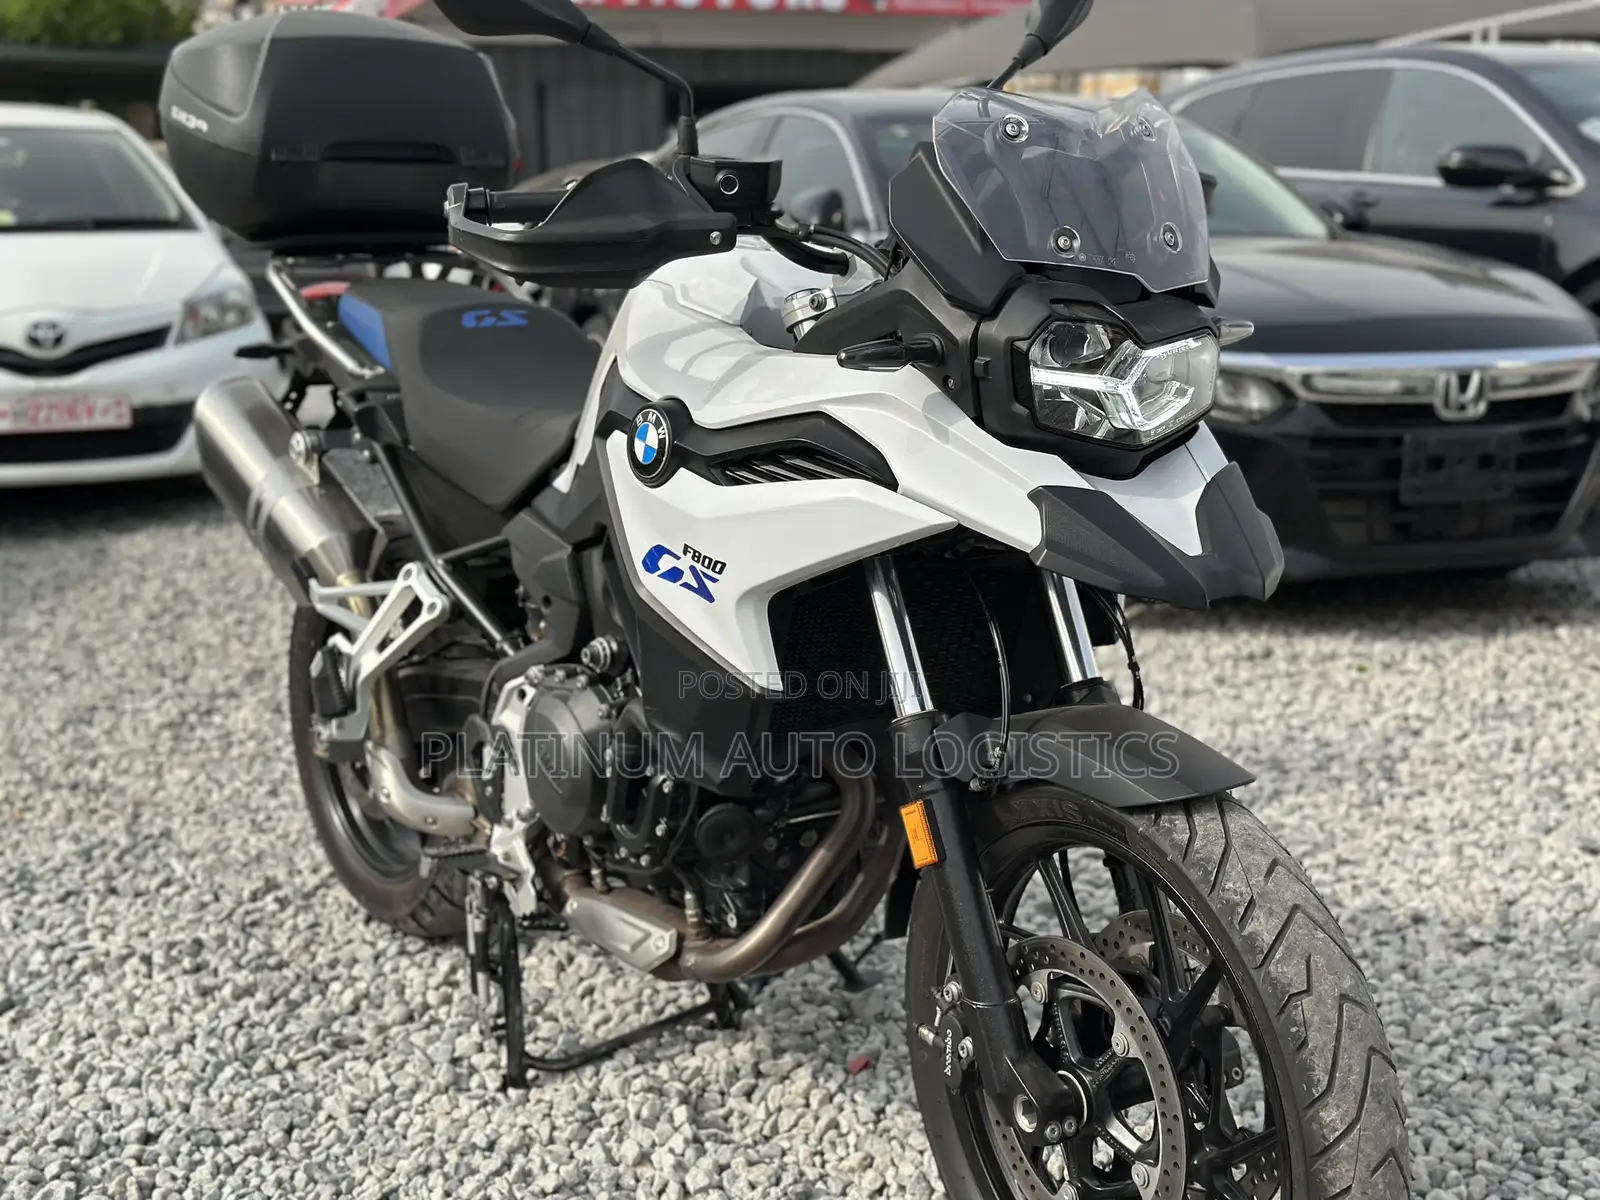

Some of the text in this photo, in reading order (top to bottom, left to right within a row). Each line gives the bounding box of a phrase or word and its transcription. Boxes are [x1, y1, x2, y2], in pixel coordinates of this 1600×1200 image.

[462, 309, 528, 328] GS
[636, 411, 666, 439] BMW
[641, 544, 720, 604] GS
[682, 543, 727, 576] F800
[944, 1028, 953, 1077] brembo
